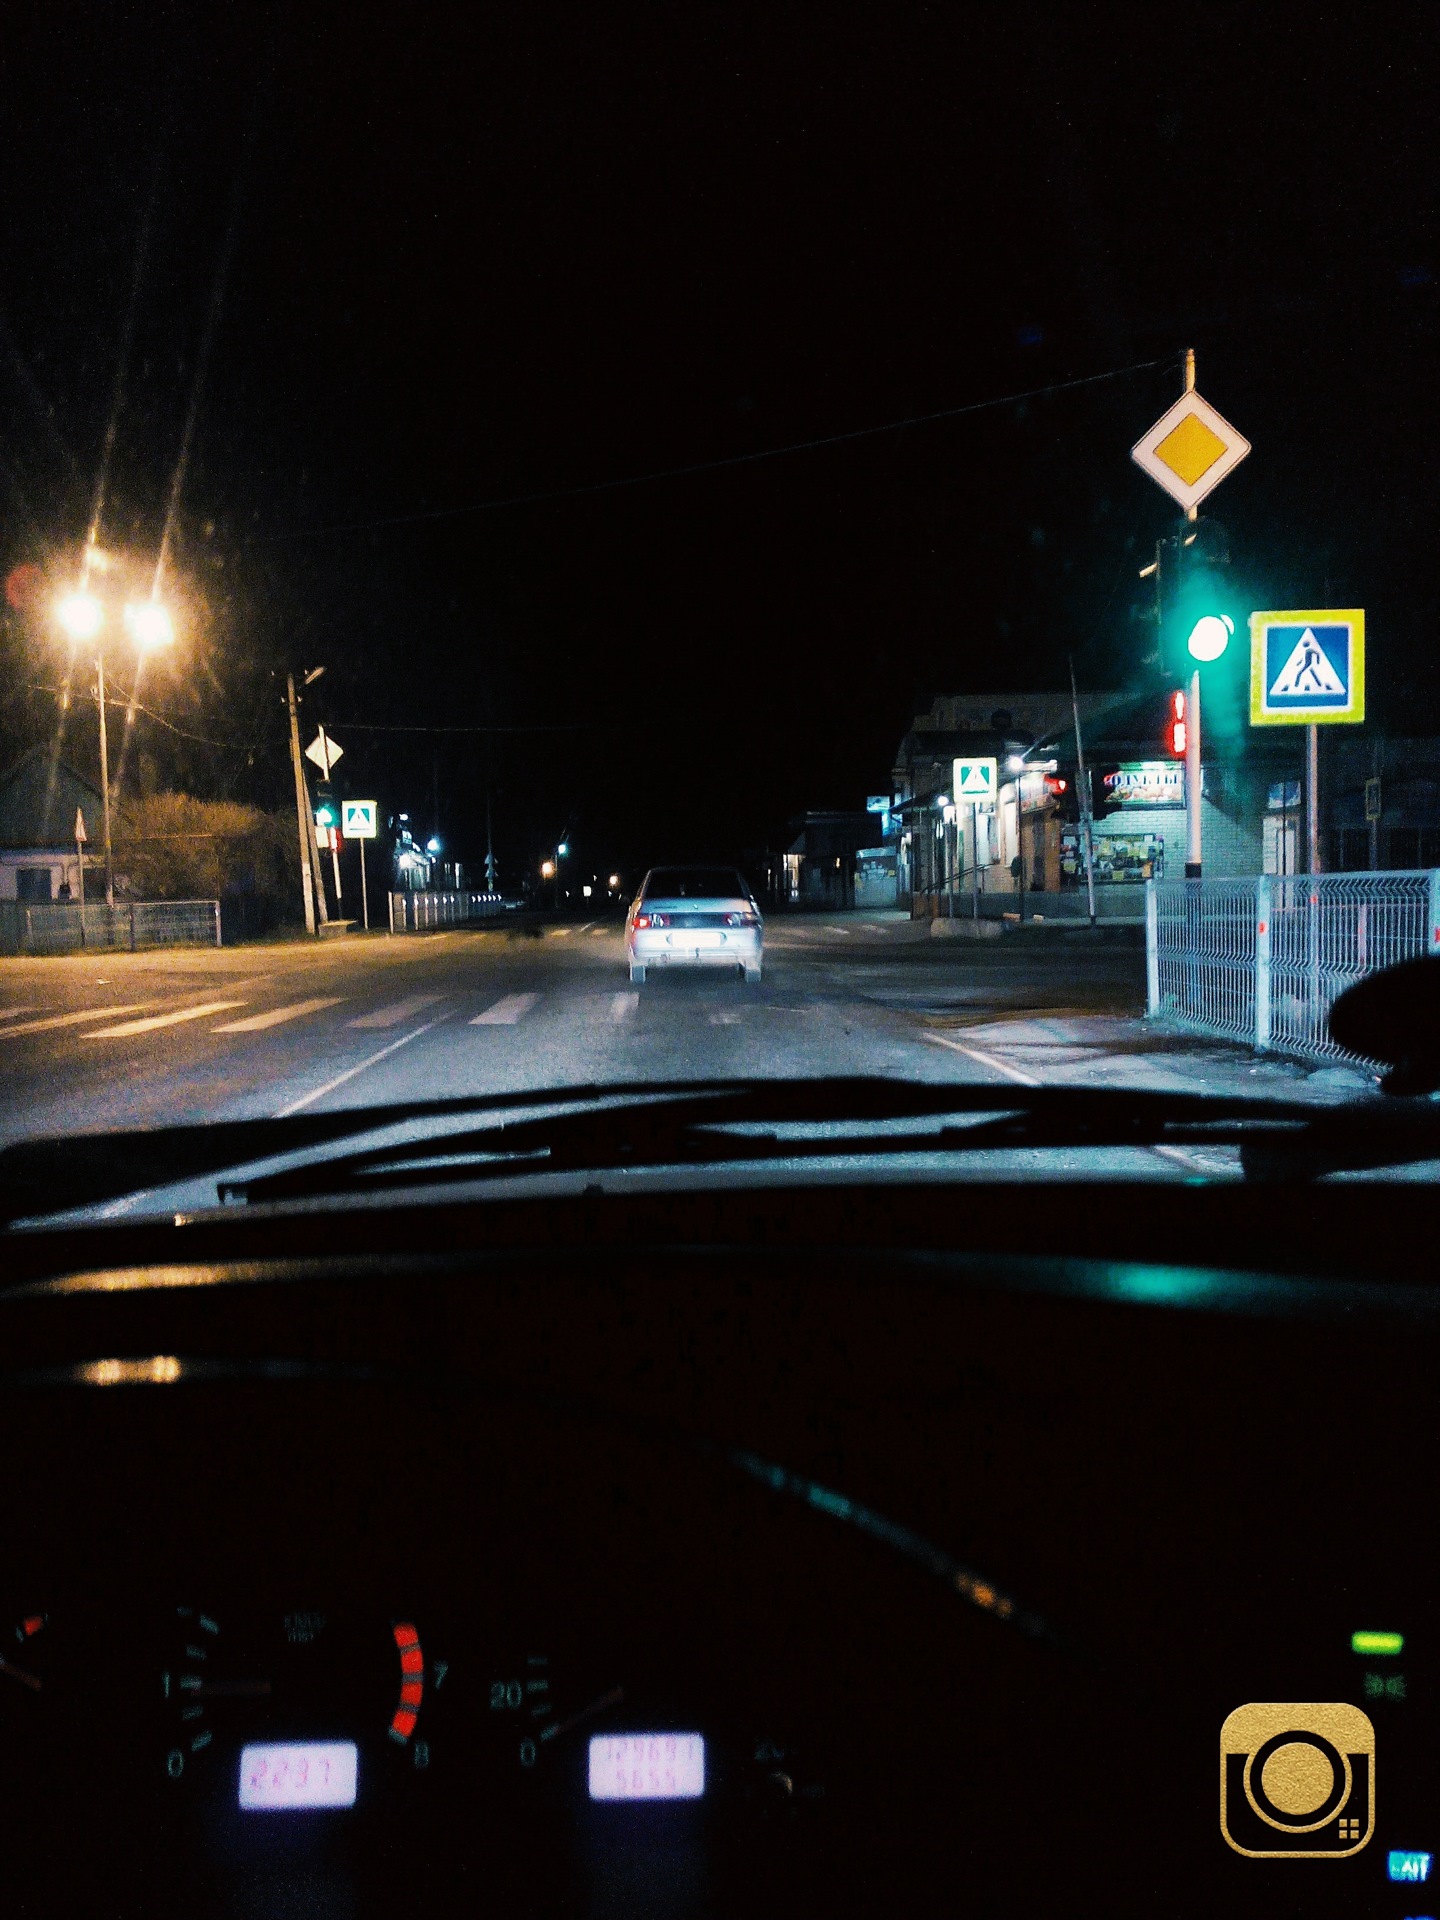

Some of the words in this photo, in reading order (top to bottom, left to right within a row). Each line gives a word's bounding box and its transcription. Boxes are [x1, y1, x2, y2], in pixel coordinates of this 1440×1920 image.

[489, 1679, 523, 1711] 20
[166, 1746, 185, 1780] 0
[519, 1736, 537, 1769] 0
